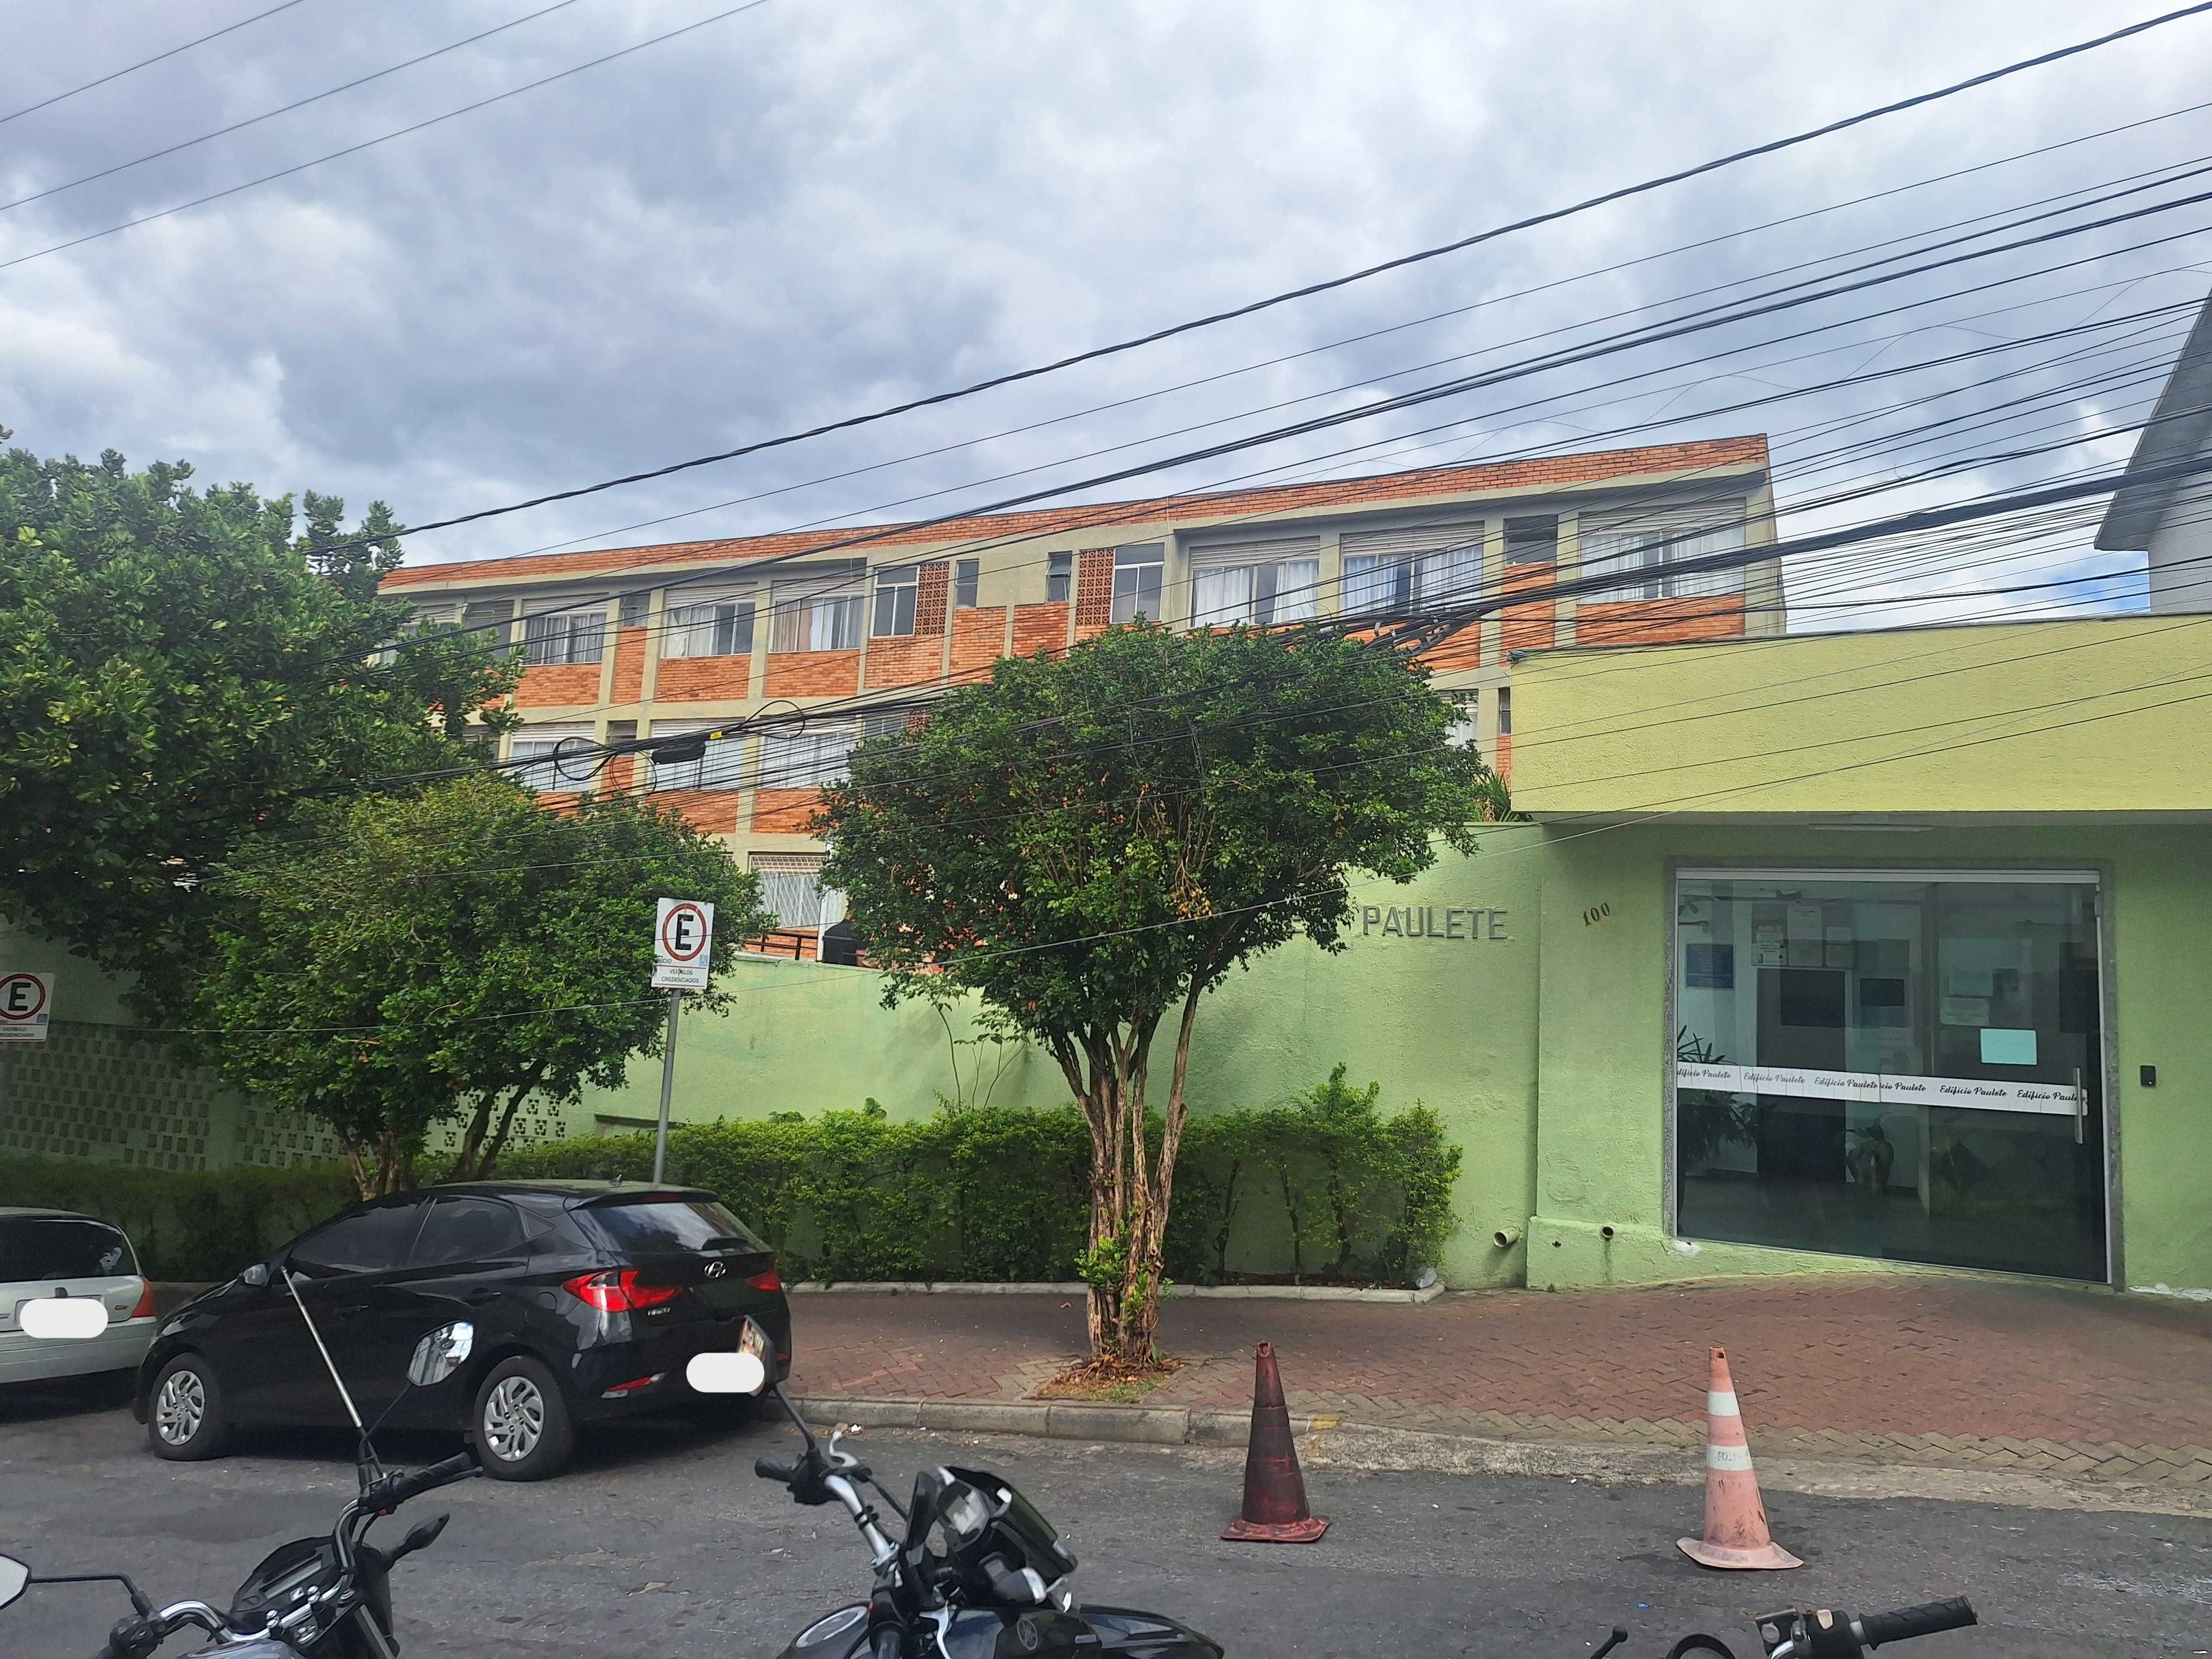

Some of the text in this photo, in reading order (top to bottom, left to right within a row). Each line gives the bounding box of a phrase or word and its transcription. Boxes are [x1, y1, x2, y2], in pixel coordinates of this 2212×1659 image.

[1583, 903, 1610, 927] 100
[1362, 905, 1507, 939] PAULETE
[675, 914, 694, 950] E
[8, 982, 31, 1011] E
[1702, 1069, 1731, 1079] Paulete
[1774, 1074, 1805, 1083] Paulete
[1847, 1079, 1878, 1089] Paulete
[1894, 1082, 1926, 1091] Paulete
[1973, 1087, 2008, 1097] Paulete
